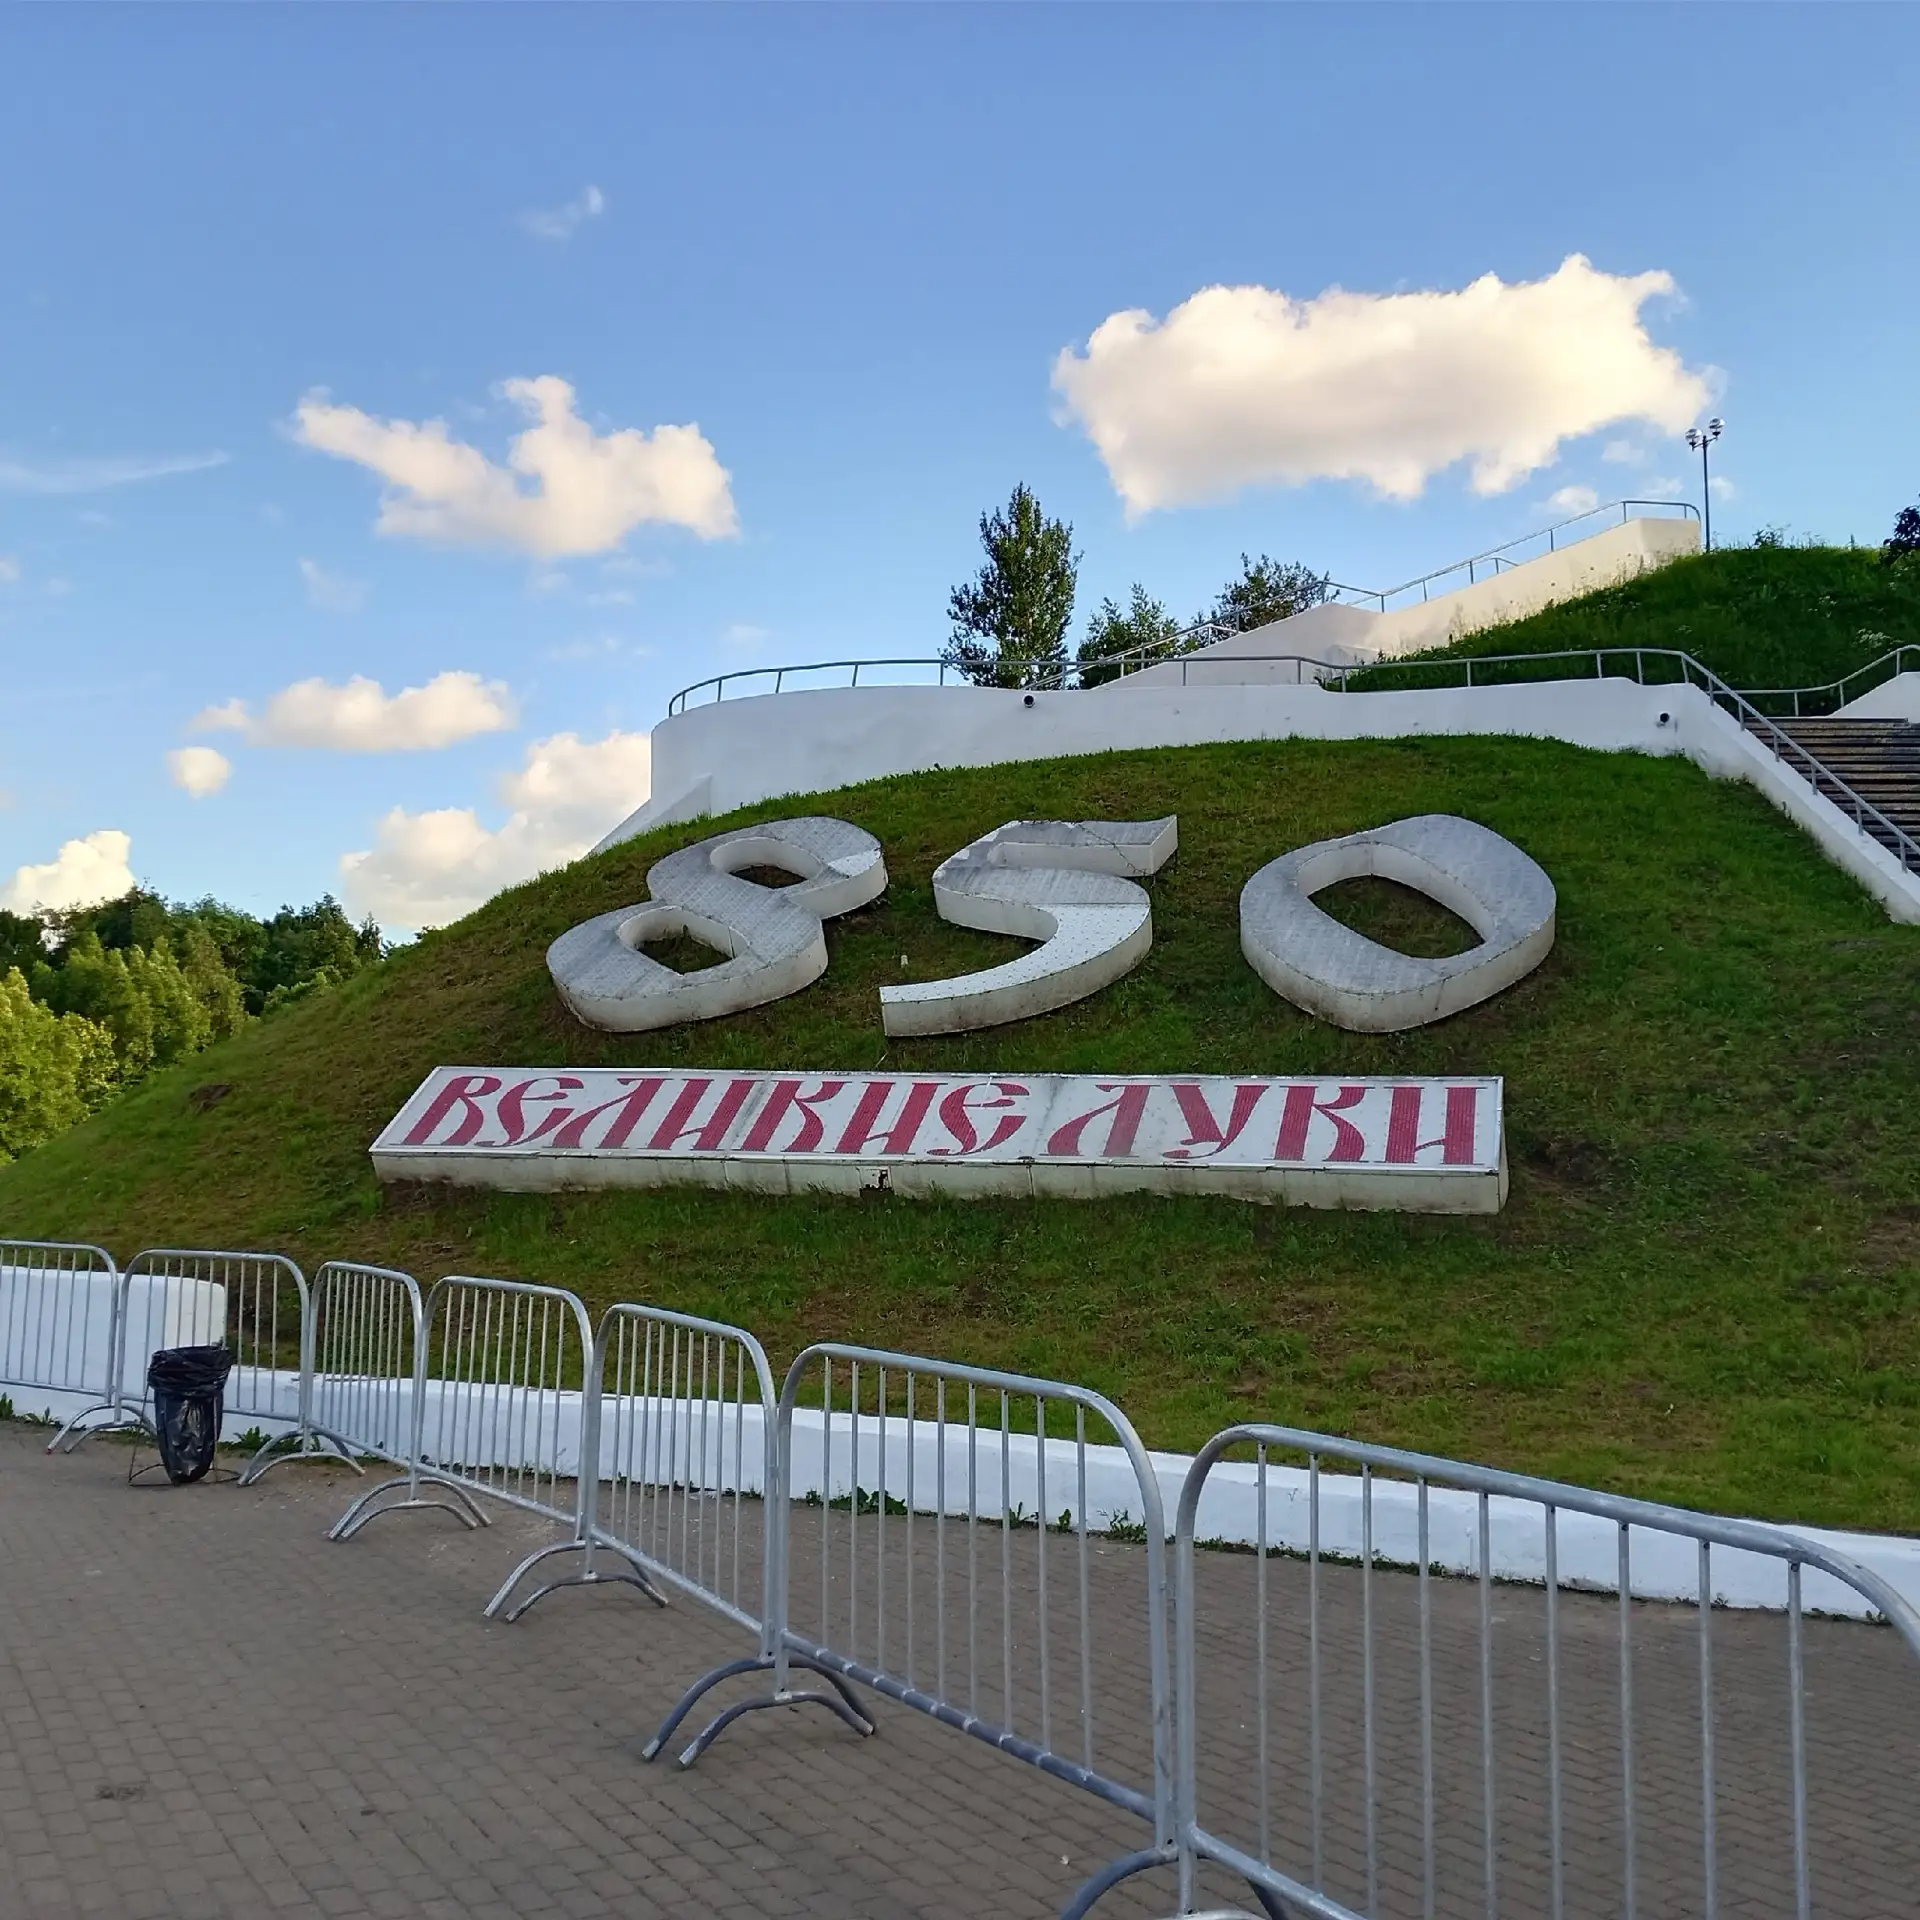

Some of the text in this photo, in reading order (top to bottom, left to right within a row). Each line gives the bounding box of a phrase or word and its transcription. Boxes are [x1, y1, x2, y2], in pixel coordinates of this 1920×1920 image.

[547, 815, 1556, 1036] 850
[394, 1076, 1483, 1165] ВЕЛИКИЕ ЛУКИ
